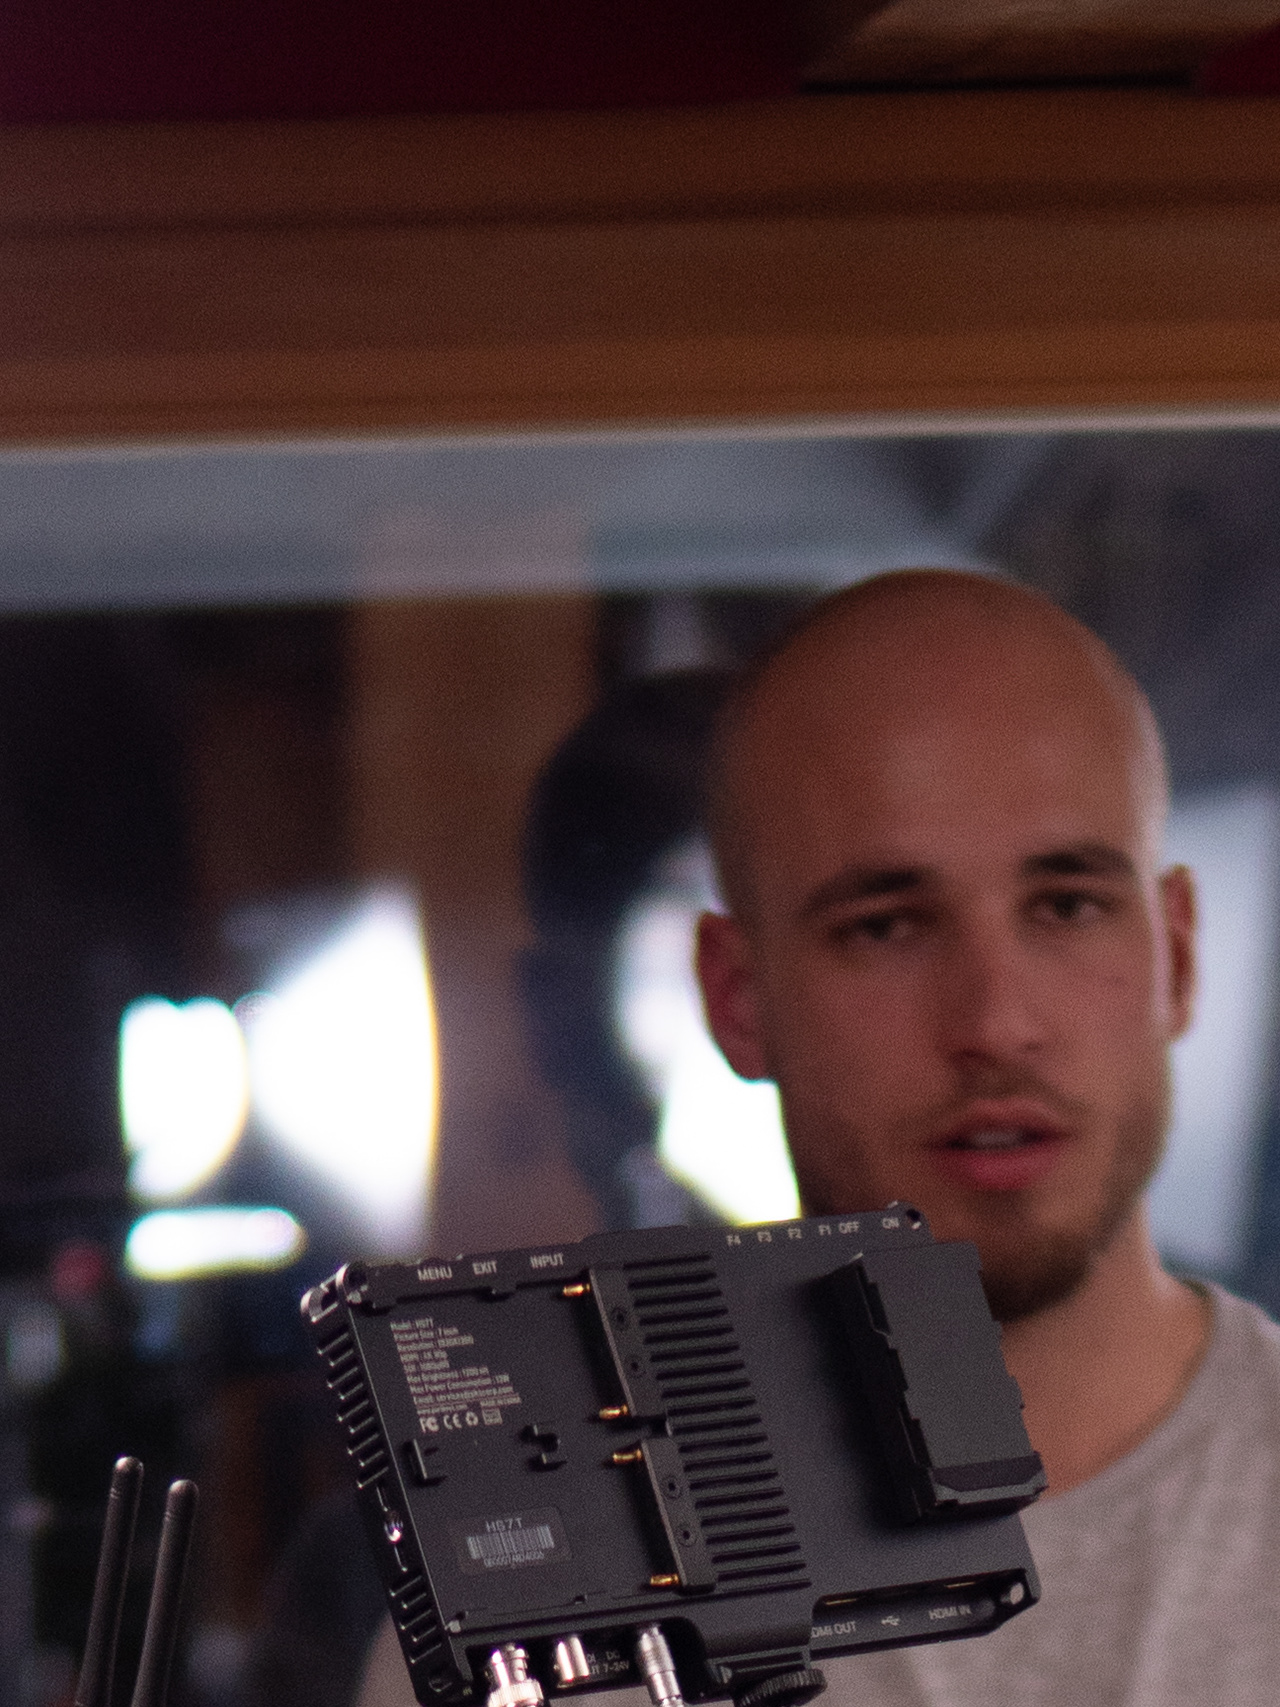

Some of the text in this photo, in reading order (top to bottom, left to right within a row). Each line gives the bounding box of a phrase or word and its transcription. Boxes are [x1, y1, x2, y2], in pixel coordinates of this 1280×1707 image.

[726, 1217, 899, 1246] F4 F3 F2 F1 OFF ON
[417, 1252, 564, 1281] MENU EXIT INPUT
[834, 1621, 857, 1635] OUT
[928, 1606, 958, 1620] HDMI
[959, 1604, 972, 1616] IN
